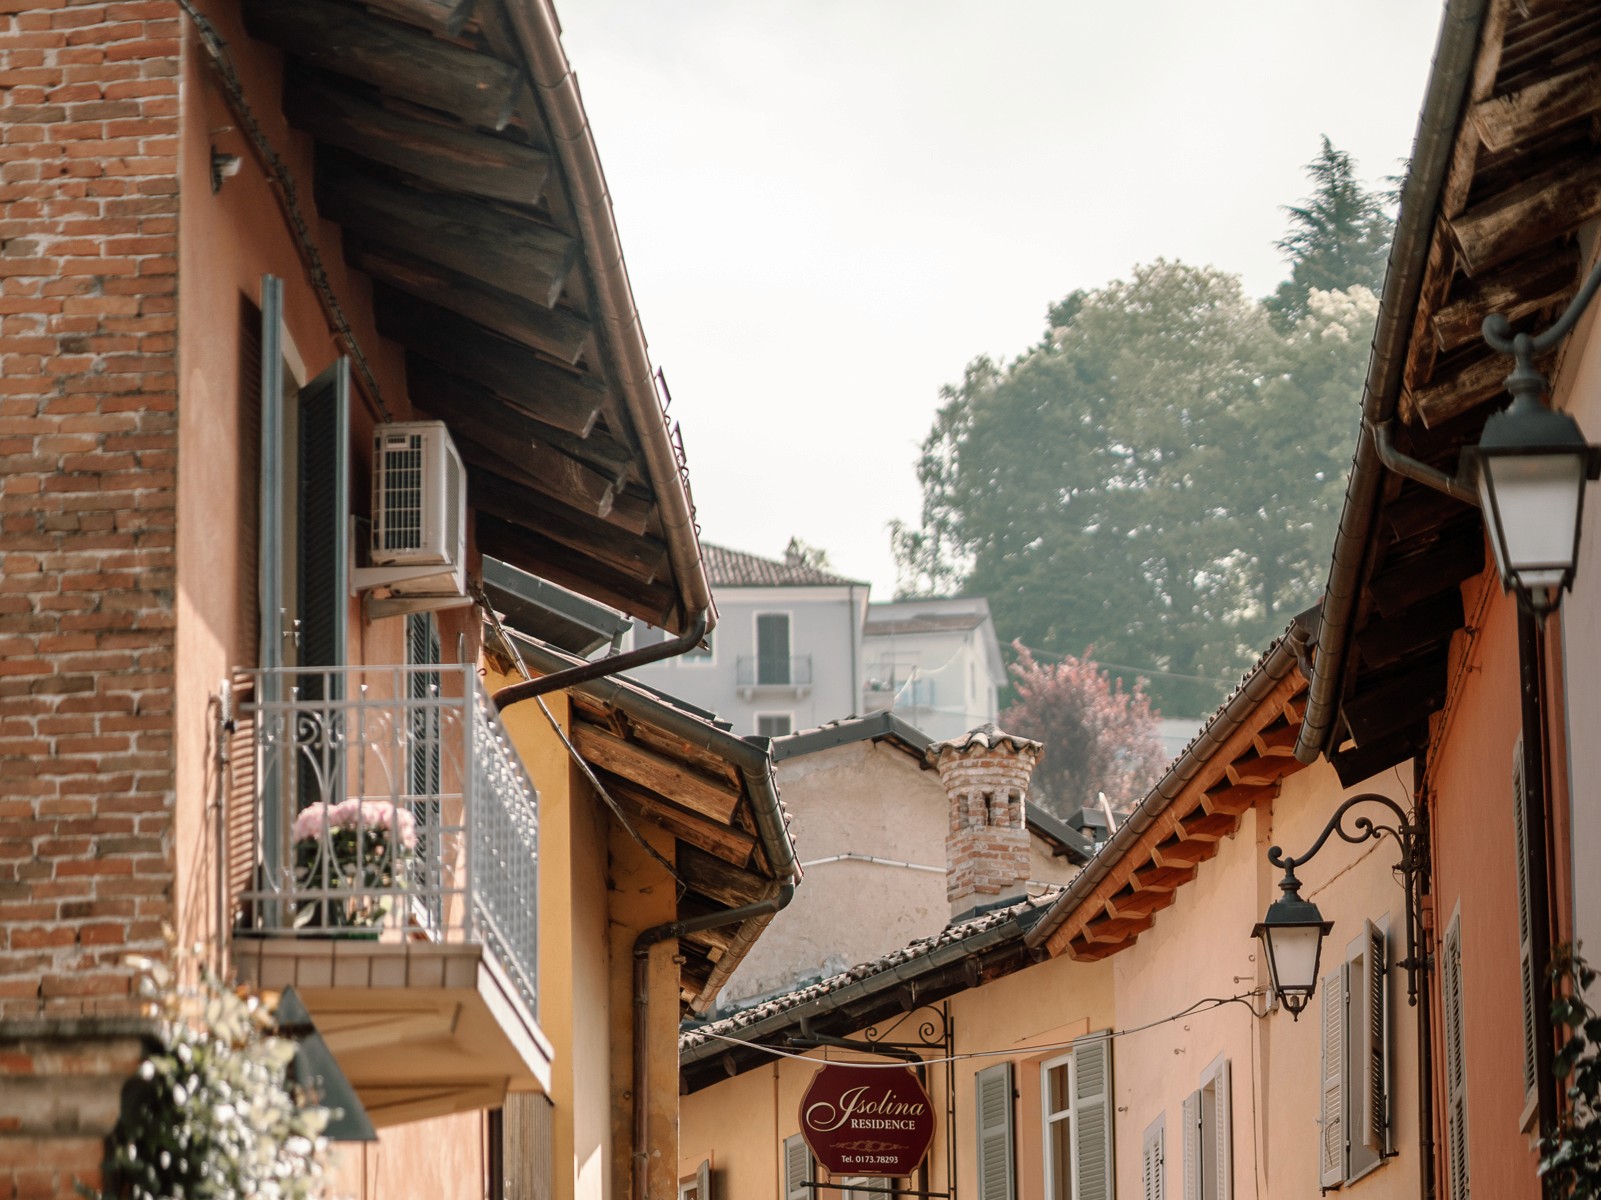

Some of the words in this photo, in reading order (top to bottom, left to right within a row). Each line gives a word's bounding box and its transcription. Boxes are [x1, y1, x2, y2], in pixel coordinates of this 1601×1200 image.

[806, 1086, 925, 1132] Isolina
[851, 1118, 915, 1130] RESIDENCE
[841, 1155, 854, 1163] Tel.
[855, 1155, 898, 1164] 0173.78293
